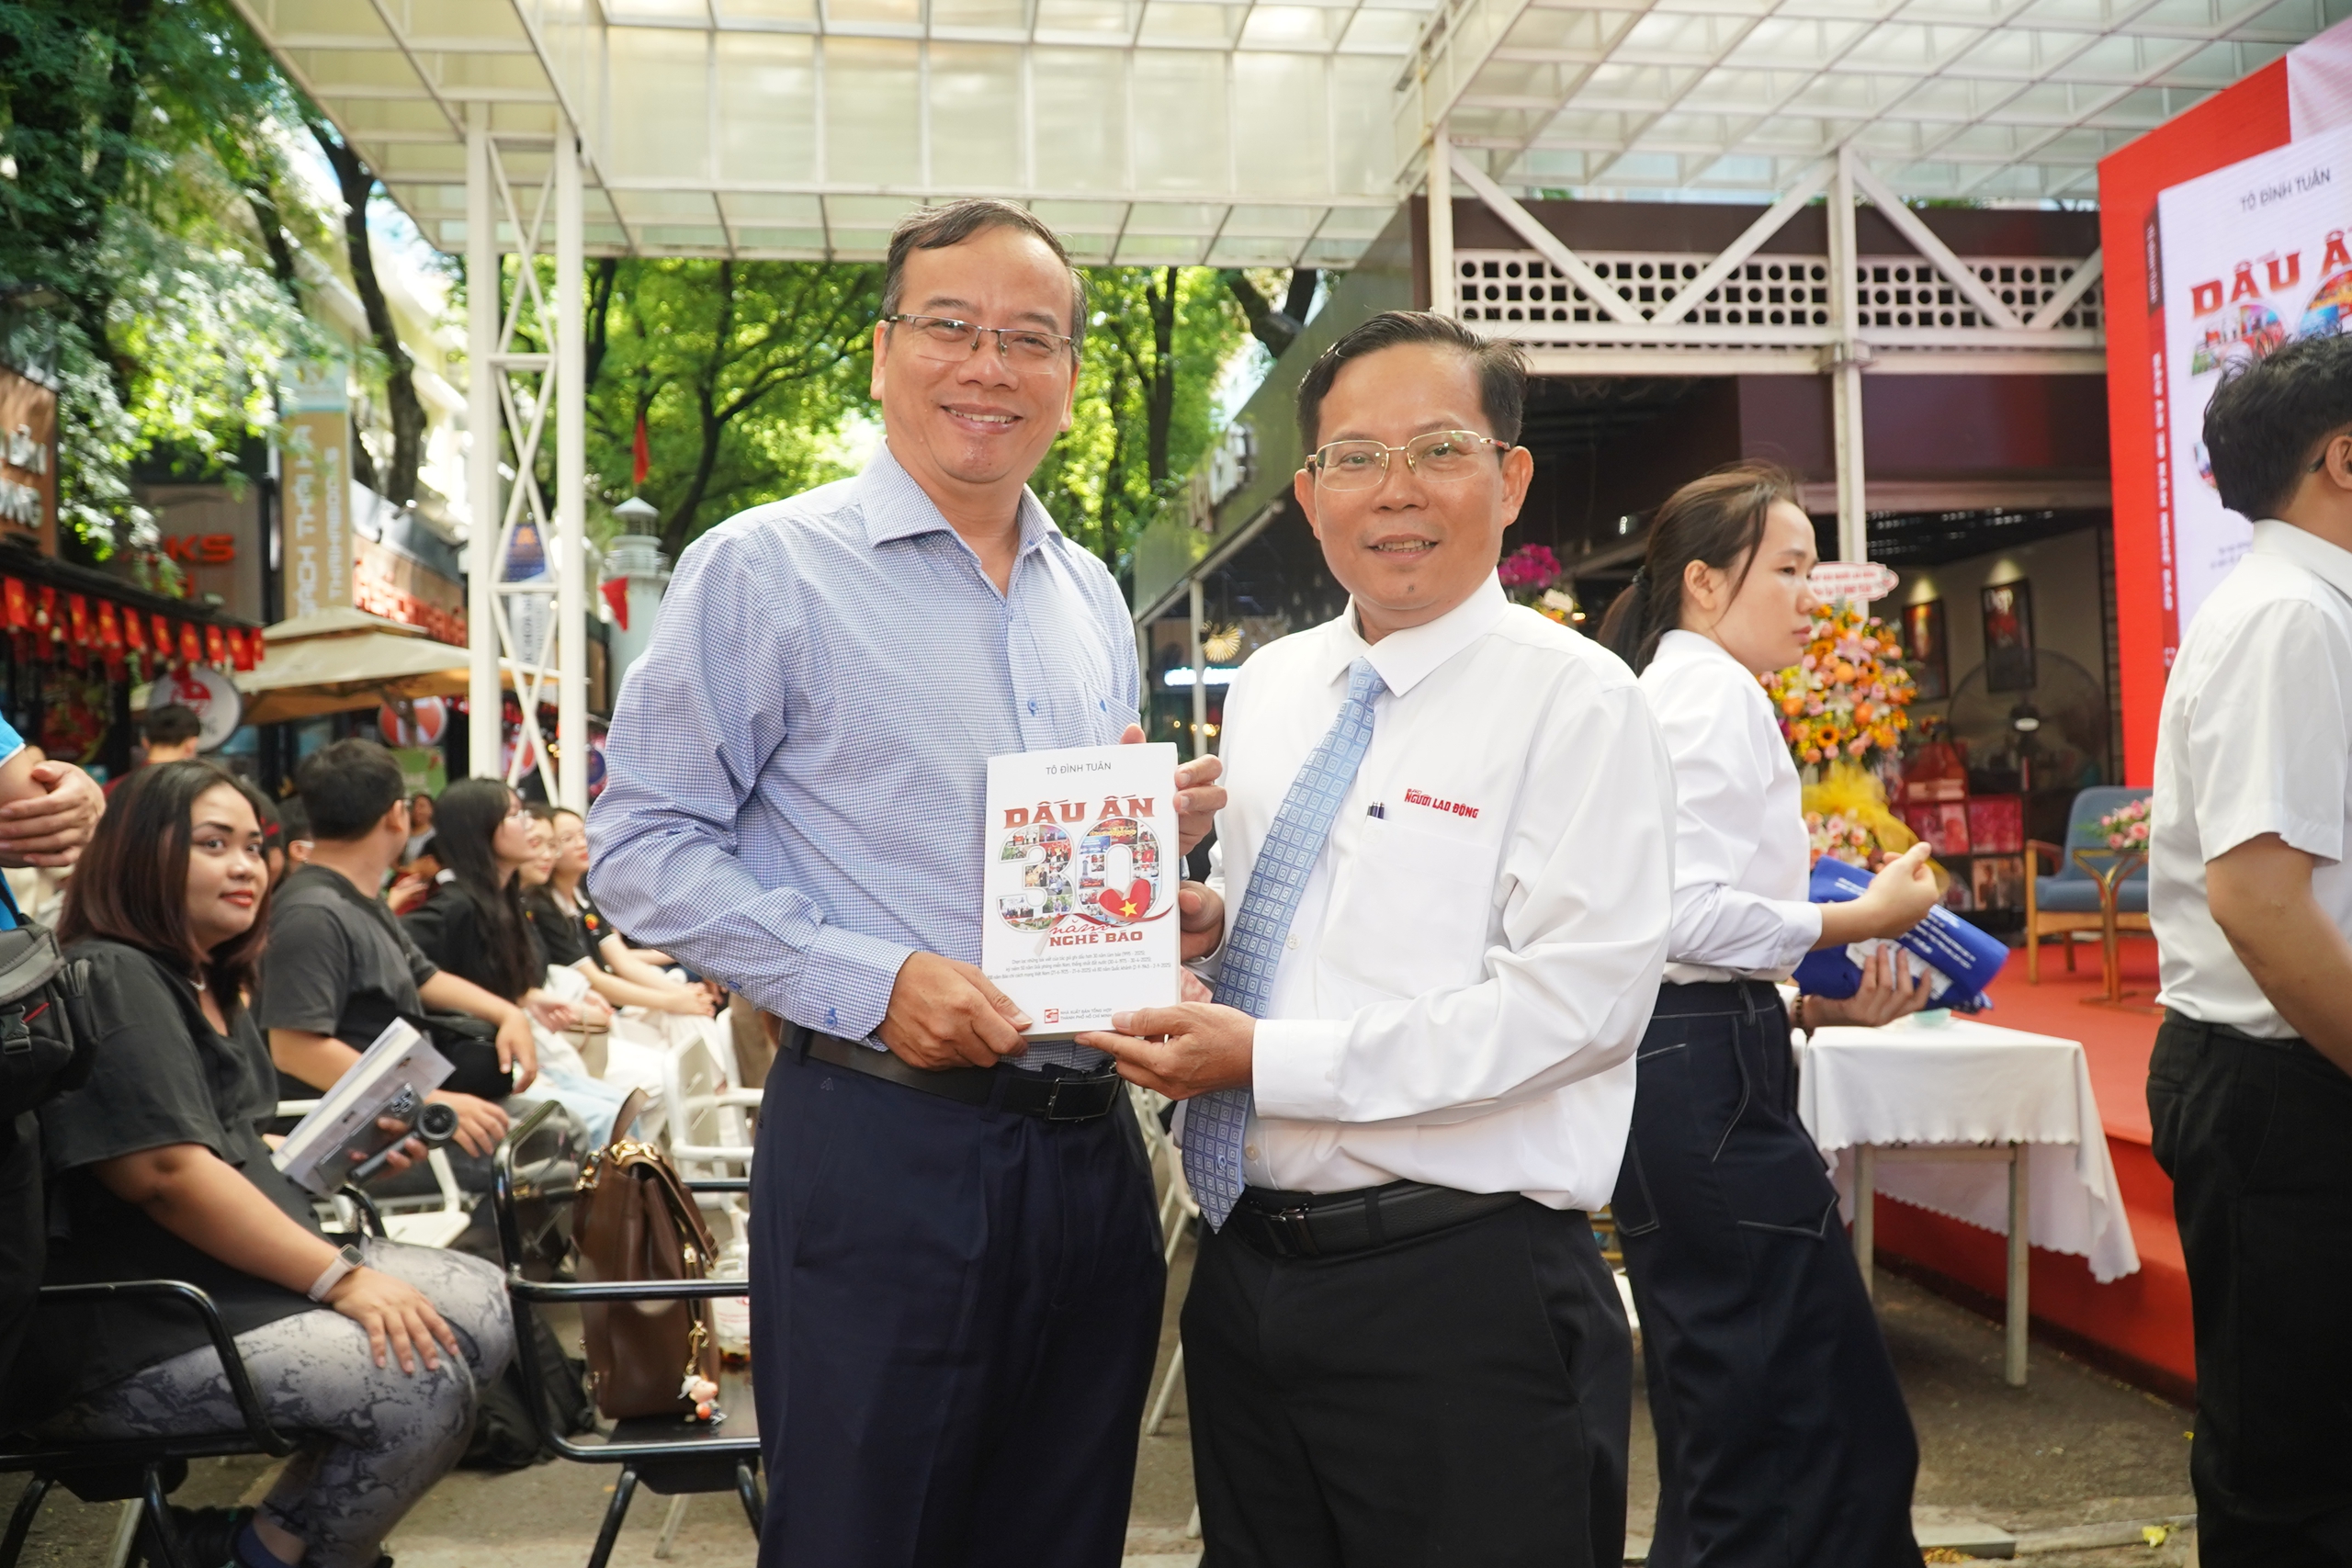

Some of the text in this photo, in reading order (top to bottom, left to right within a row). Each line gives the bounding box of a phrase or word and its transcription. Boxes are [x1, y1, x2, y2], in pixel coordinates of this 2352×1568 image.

[2241, 189, 2256, 211] TÔ
[2260, 182, 2292, 207] ĐÌNH
[2190, 249, 2301, 320] DẤU
[1046, 761, 1112, 775] TÔ ĐÌNH TUÂN
[1003, 794, 1157, 829] DẤU ẤN
[1404, 792, 1480, 818] NGƯỜI LAO ĐỘNG
[1049, 931, 1100, 947] NGHỀ
